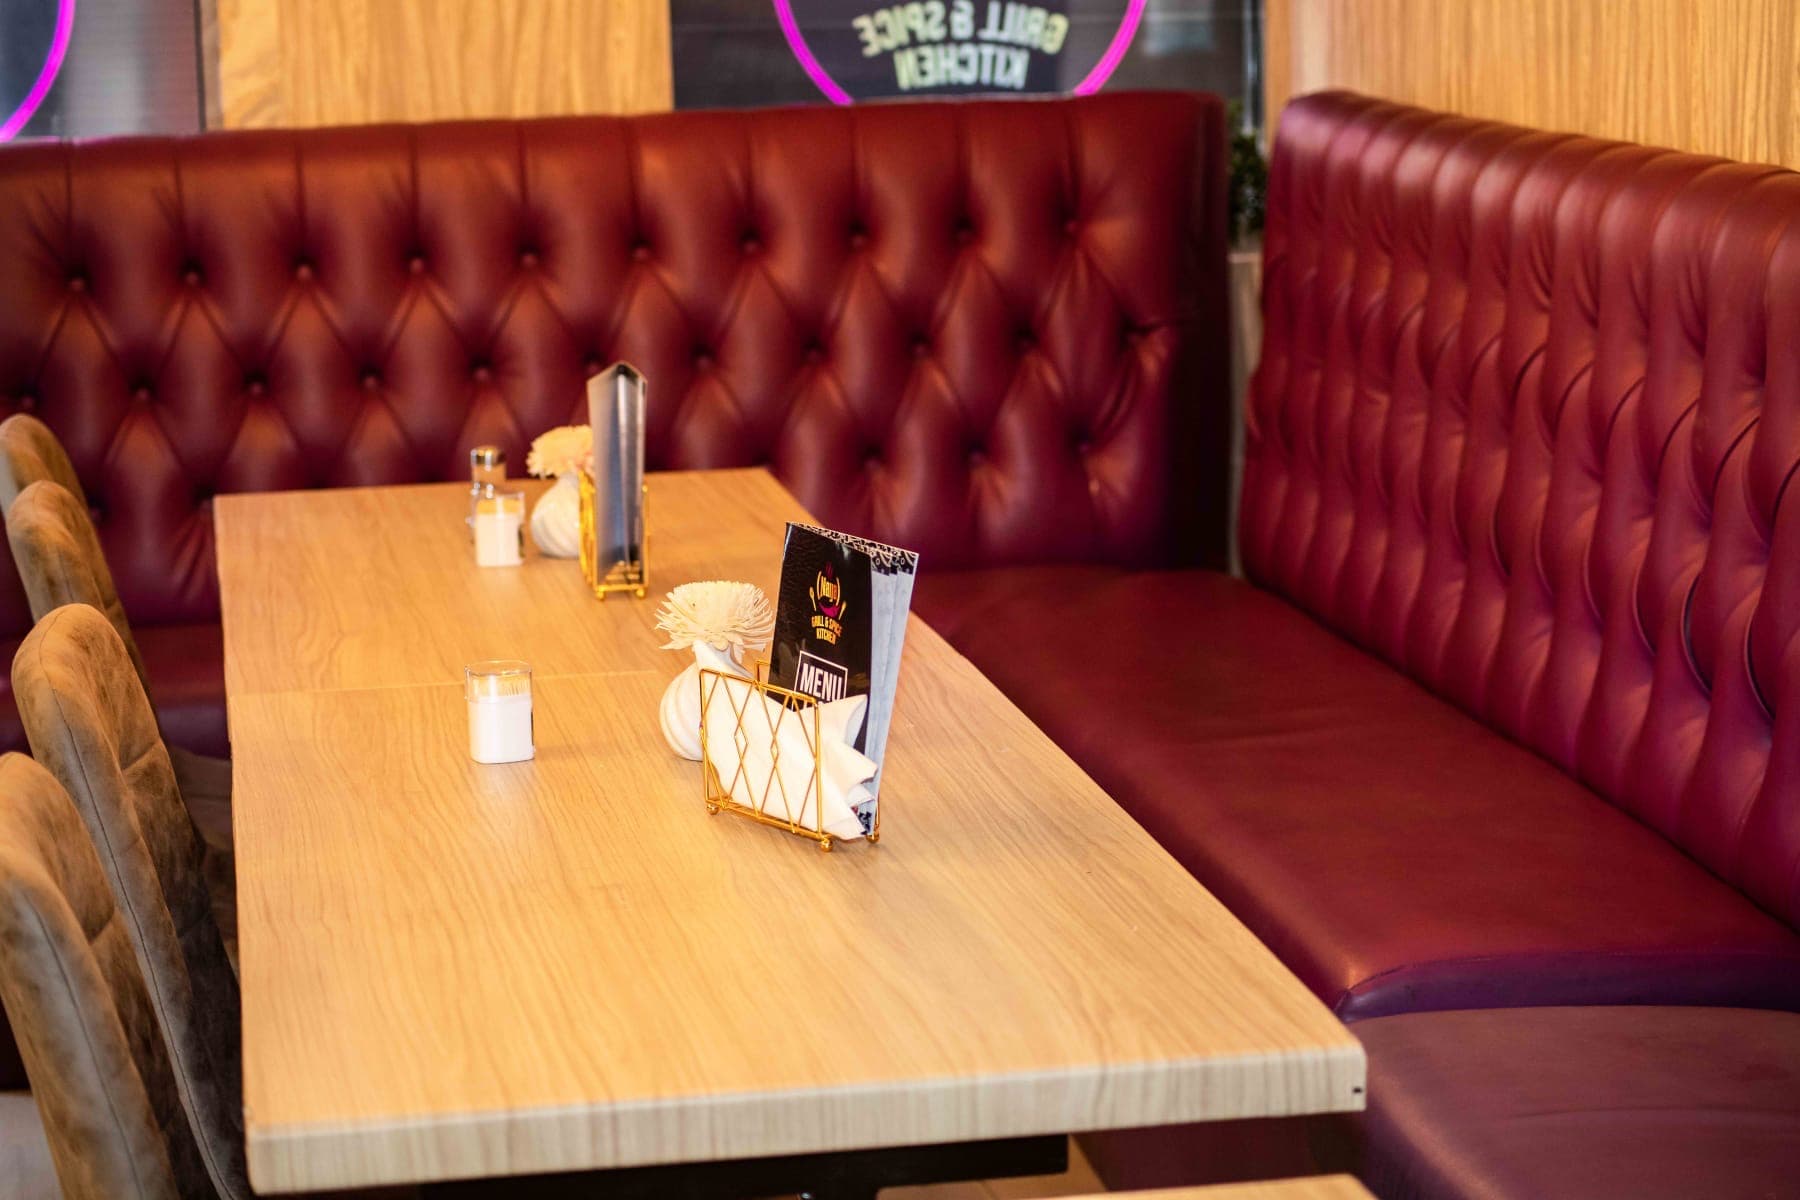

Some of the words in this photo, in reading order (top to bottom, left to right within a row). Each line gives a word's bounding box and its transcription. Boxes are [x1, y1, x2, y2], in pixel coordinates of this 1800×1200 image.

[811, 615, 825, 628] GRILL
[829, 618, 842, 637] SPICE
[816, 627, 837, 646] KITCHEN
[800, 662, 843, 701] MENU
